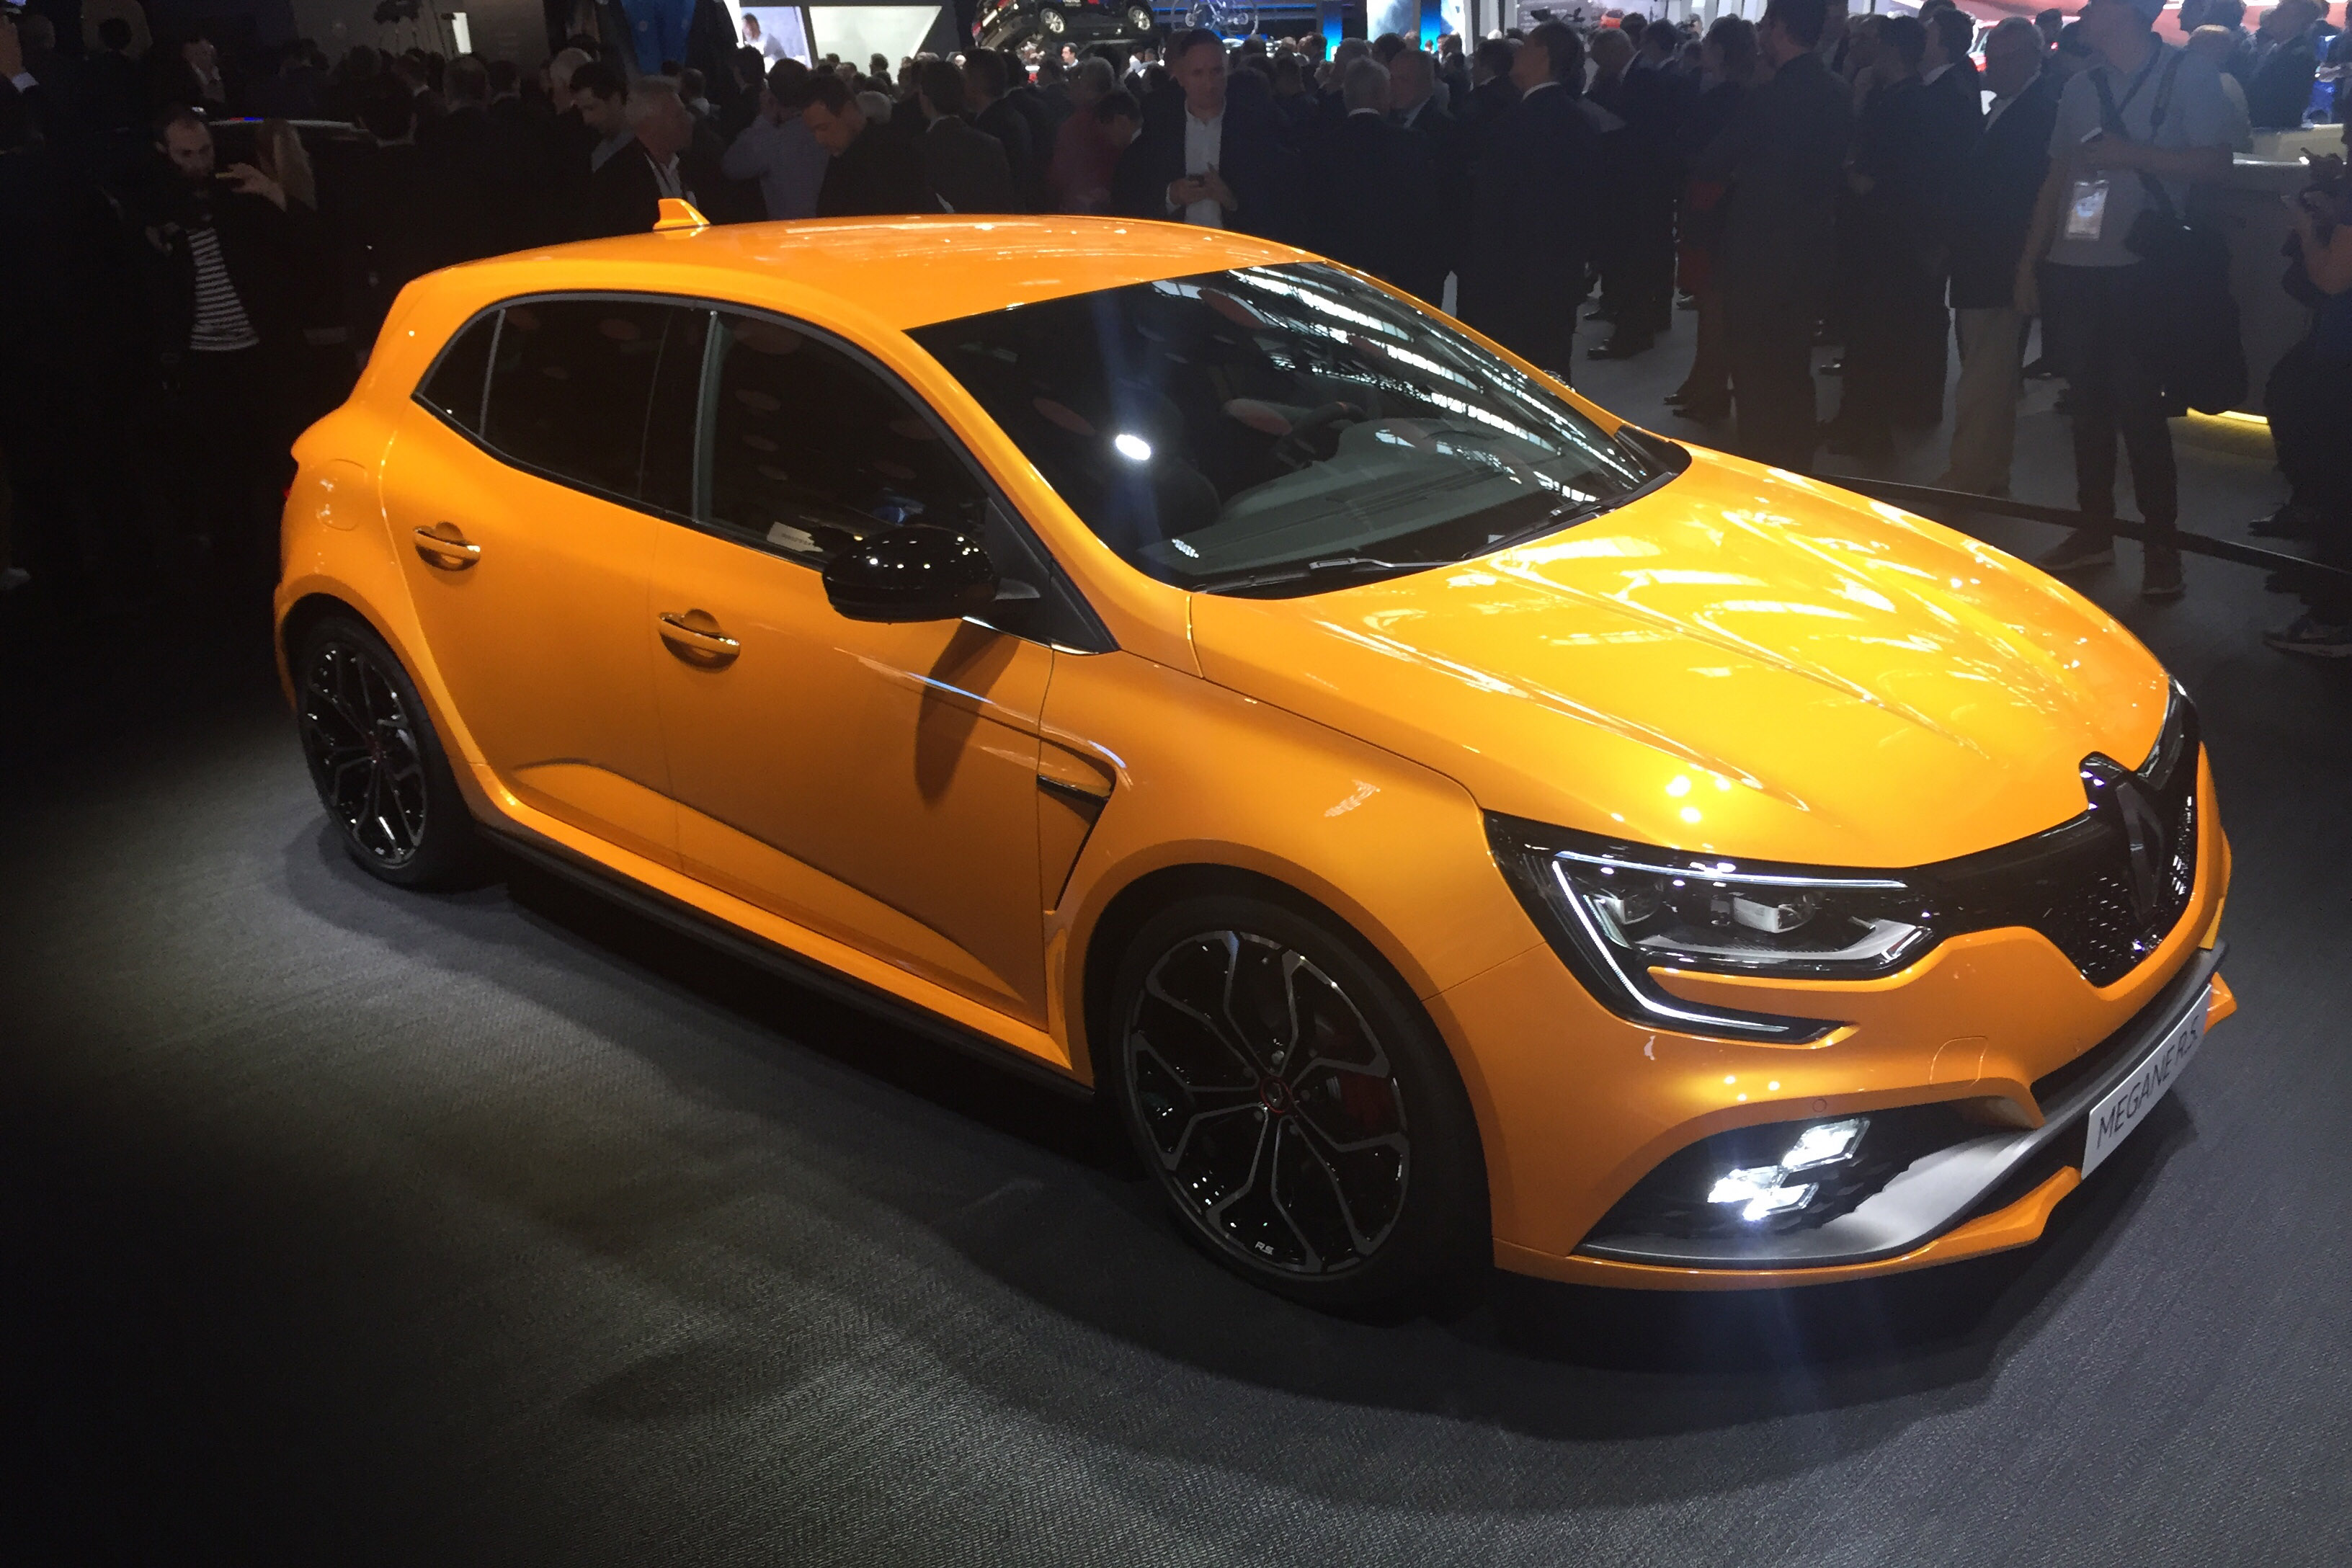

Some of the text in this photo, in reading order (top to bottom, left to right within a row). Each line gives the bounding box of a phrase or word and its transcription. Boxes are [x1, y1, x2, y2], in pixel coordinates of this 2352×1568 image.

[2096, 1015, 2199, 1149] MEGANE RS
[1255, 1241, 1274, 1255] RS
